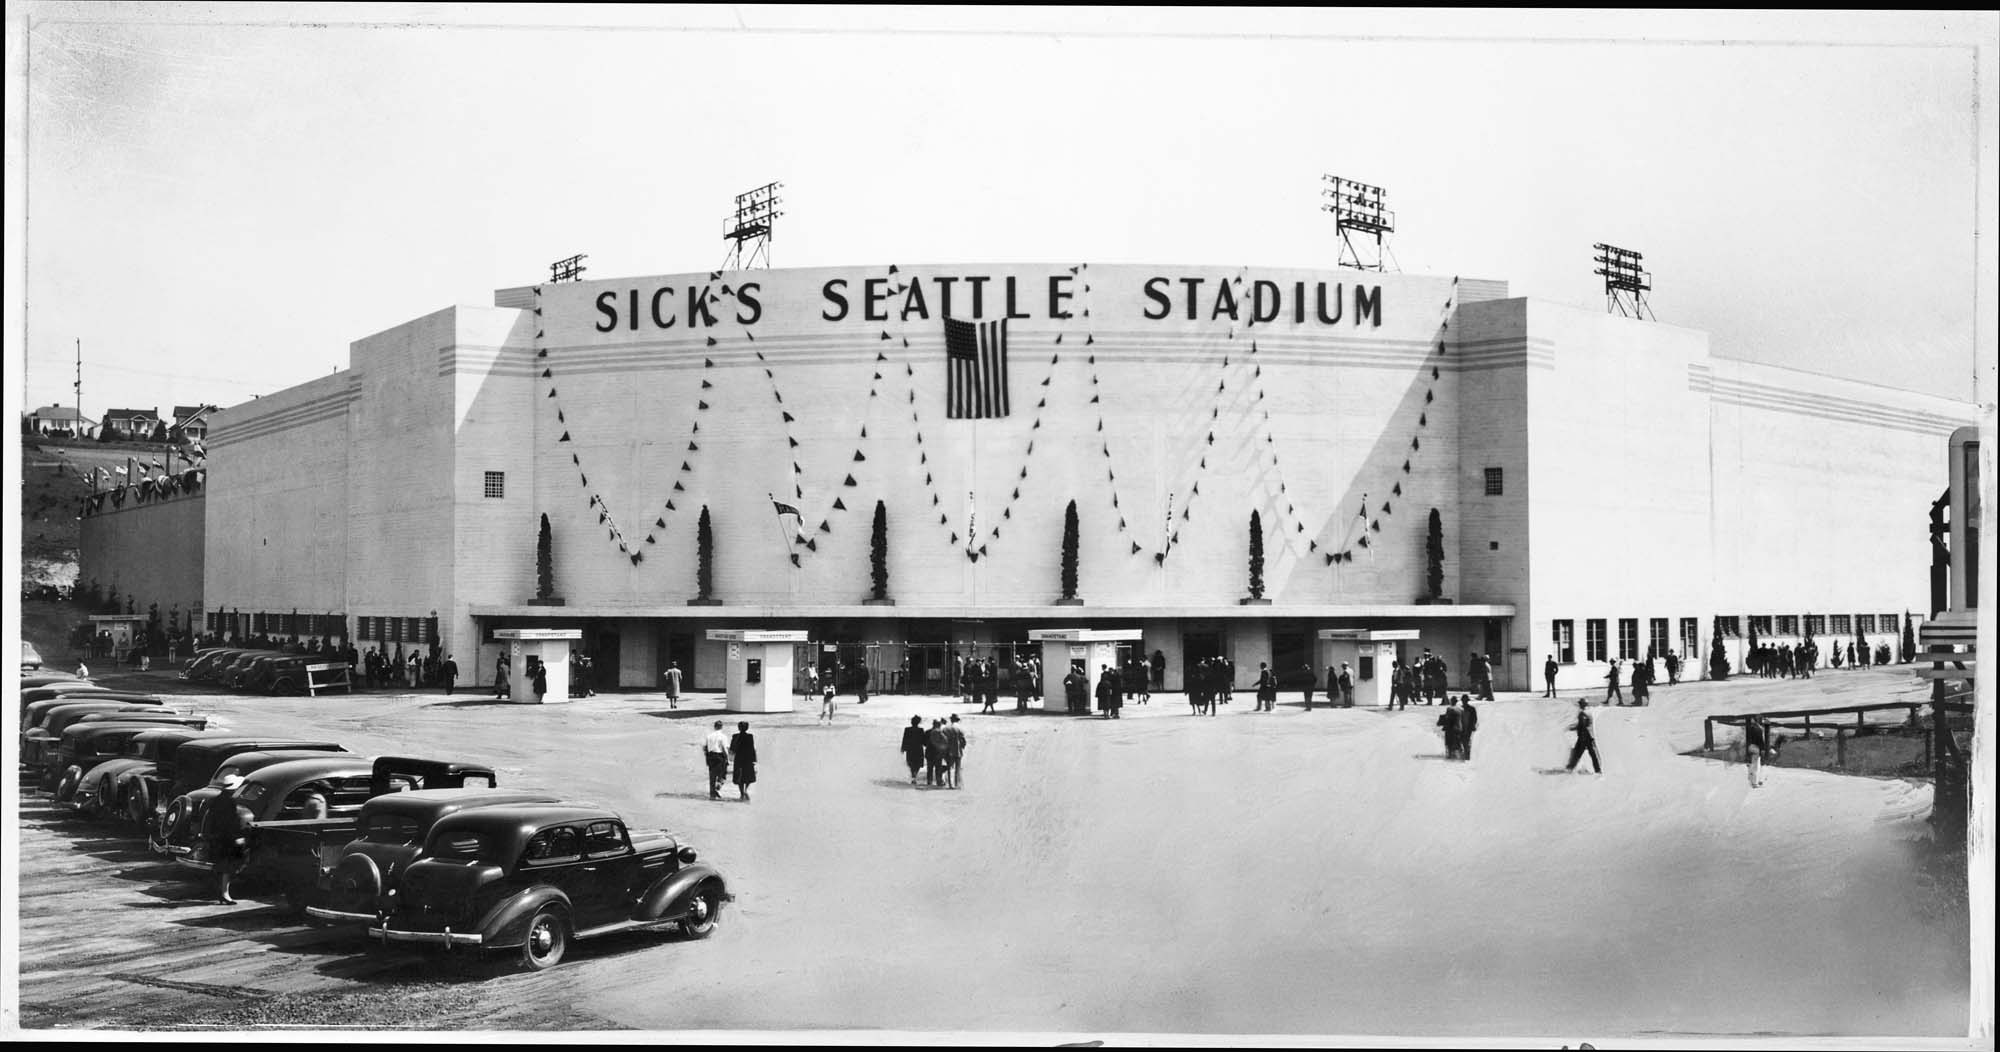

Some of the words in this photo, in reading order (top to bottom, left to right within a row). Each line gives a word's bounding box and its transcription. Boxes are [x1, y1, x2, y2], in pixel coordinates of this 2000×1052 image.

[595, 282, 763, 333] SICK'S
[821, 275, 1074, 322] SEATTLE
[1142, 276, 1383, 328] STADIUM
